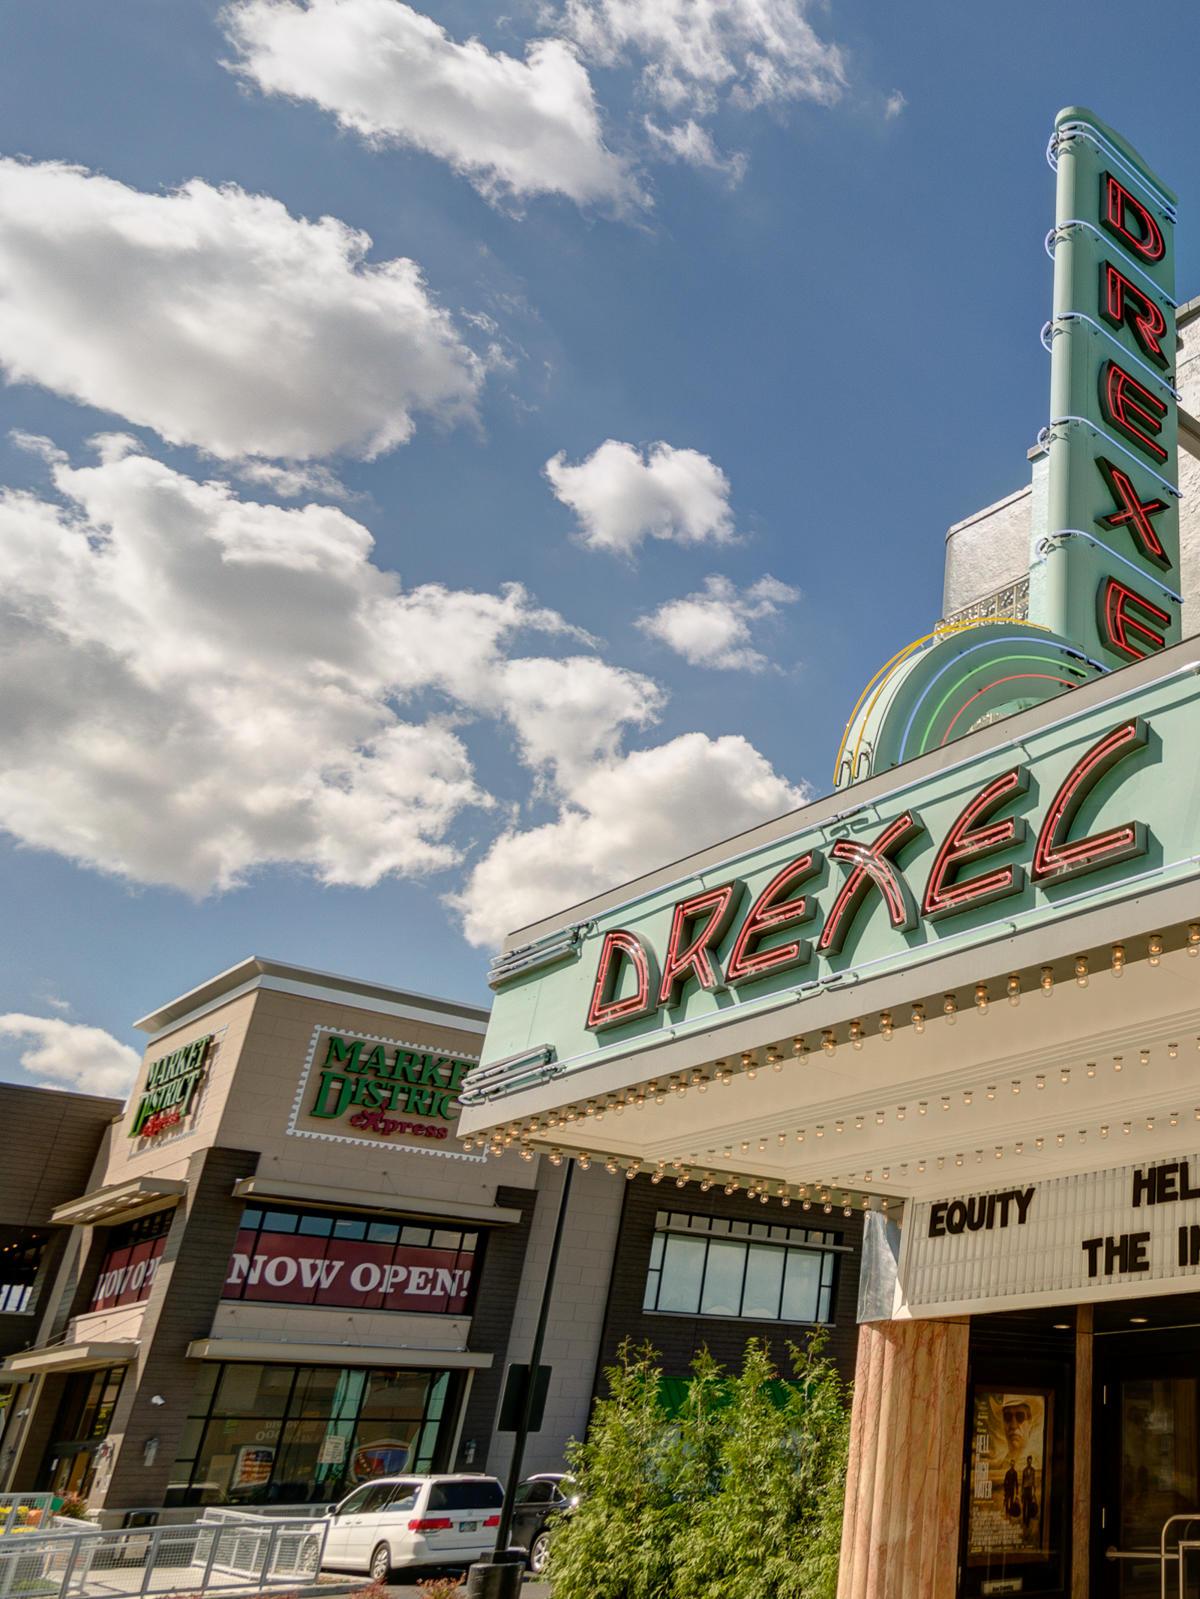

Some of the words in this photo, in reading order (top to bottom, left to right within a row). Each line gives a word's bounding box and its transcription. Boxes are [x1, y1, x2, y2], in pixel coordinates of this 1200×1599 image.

[585, 716, 1150, 1032] DREXEL
[145, 1034, 211, 1090] MARKET
[928, 1188, 1035, 1237] EQUITY
[226, 1253, 344, 1289] NOW
[350, 1262, 472, 1297] OPEN!
[1082, 1231, 1150, 1277] THE
